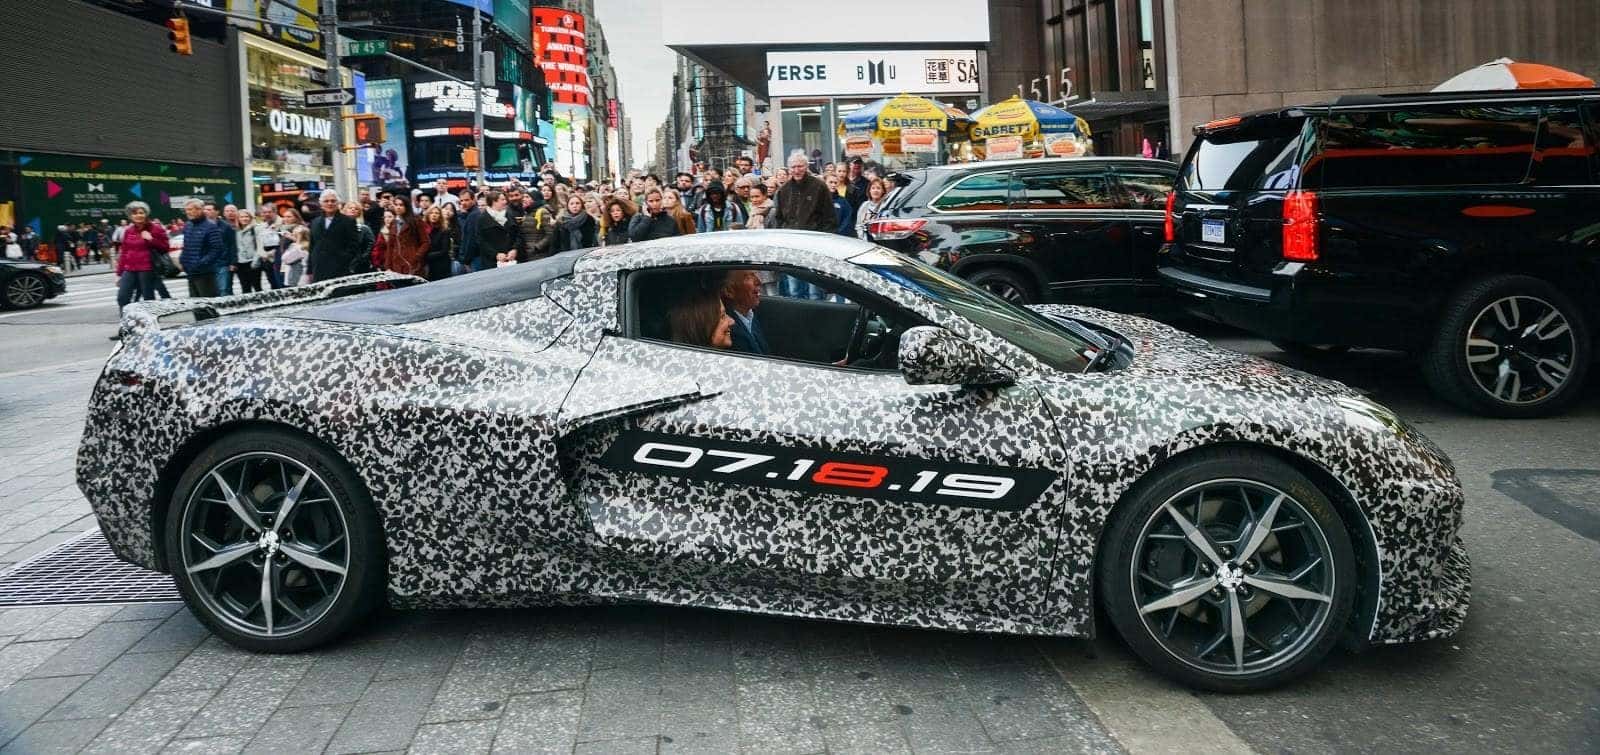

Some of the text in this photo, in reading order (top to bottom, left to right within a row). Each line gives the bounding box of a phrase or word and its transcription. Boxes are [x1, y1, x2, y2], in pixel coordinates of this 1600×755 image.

[351, 43, 360, 53] W
[364, 42, 375, 53] 45
[311, 95, 327, 104] ONE
[269, 109, 332, 141] OLD NAV
[883, 118, 942, 128] SABRETT
[974, 123, 1032, 138] SABRETT
[632, 442, 1016, 500] 07.18.19
